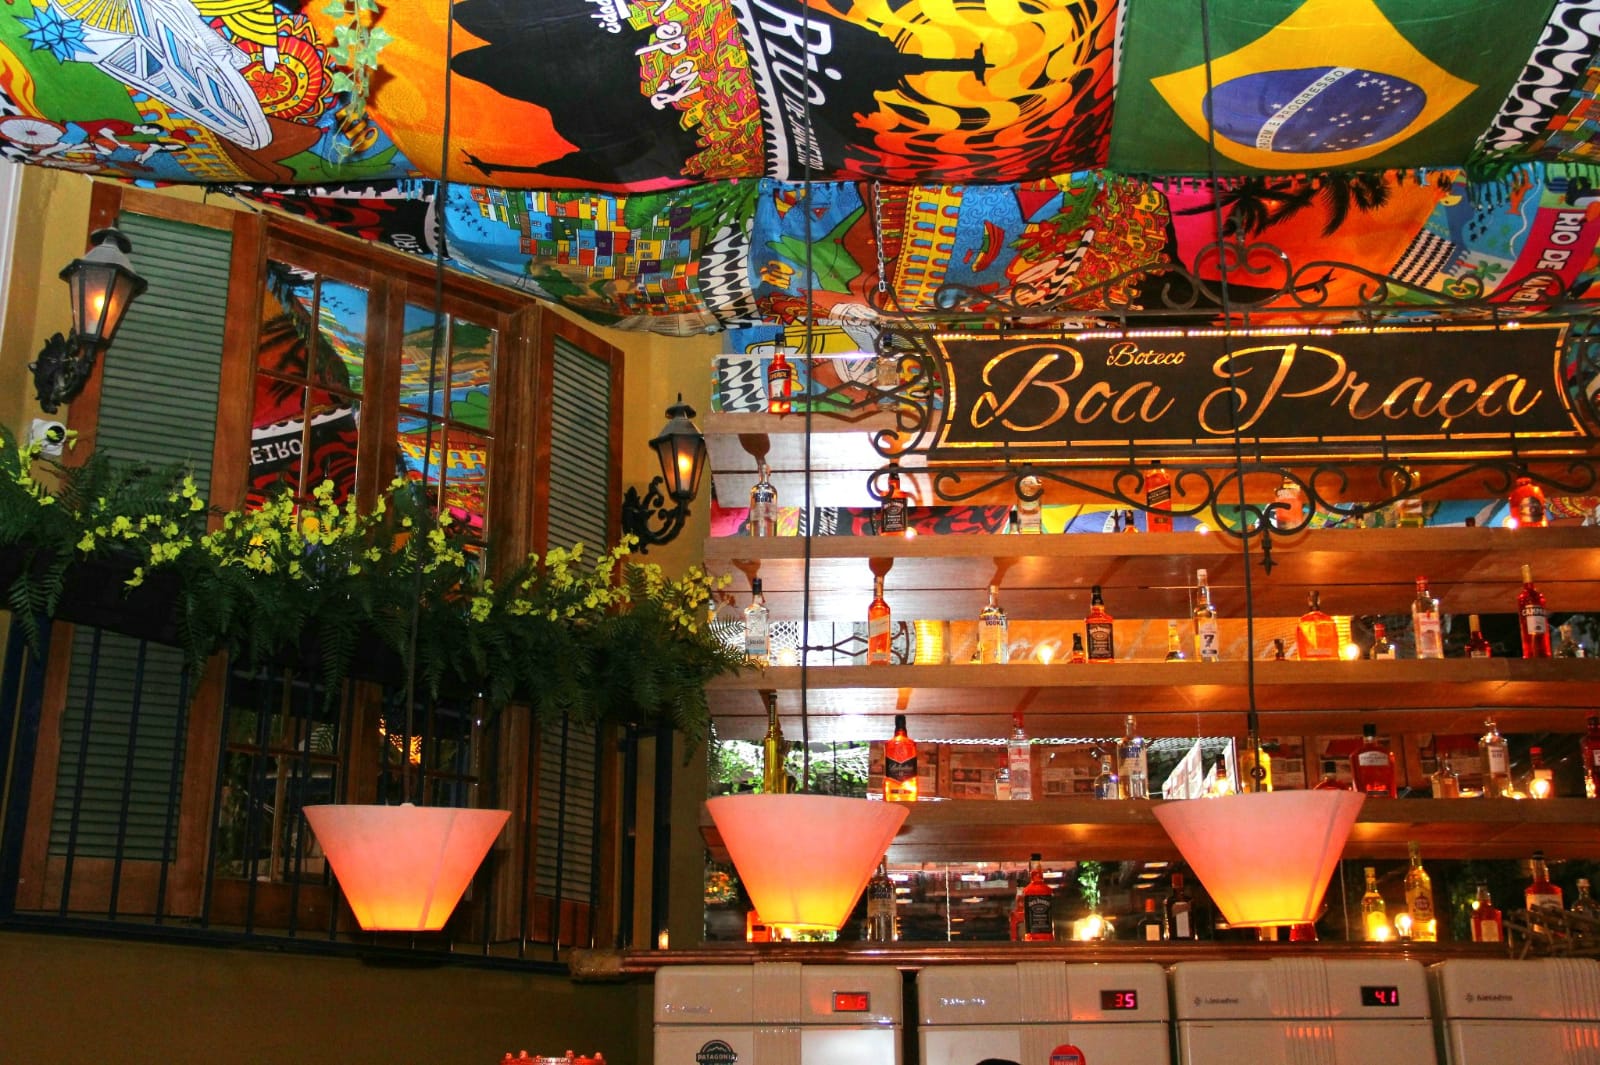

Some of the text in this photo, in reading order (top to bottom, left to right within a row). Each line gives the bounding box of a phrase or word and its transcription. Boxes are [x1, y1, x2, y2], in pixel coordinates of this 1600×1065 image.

[635, 21, 701, 110] Rio de
[1275, 70, 1345, 119] PROGRESSO
[1551, 212, 1586, 245] RIO
[1536, 249, 1571, 270] DE
[1106, 341, 1187, 368] Boteco
[970, 342, 1543, 435] Boa Praça
[1203, 634, 1215, 648] 7
[697, 1053, 738, 1061] PATAGONIA
